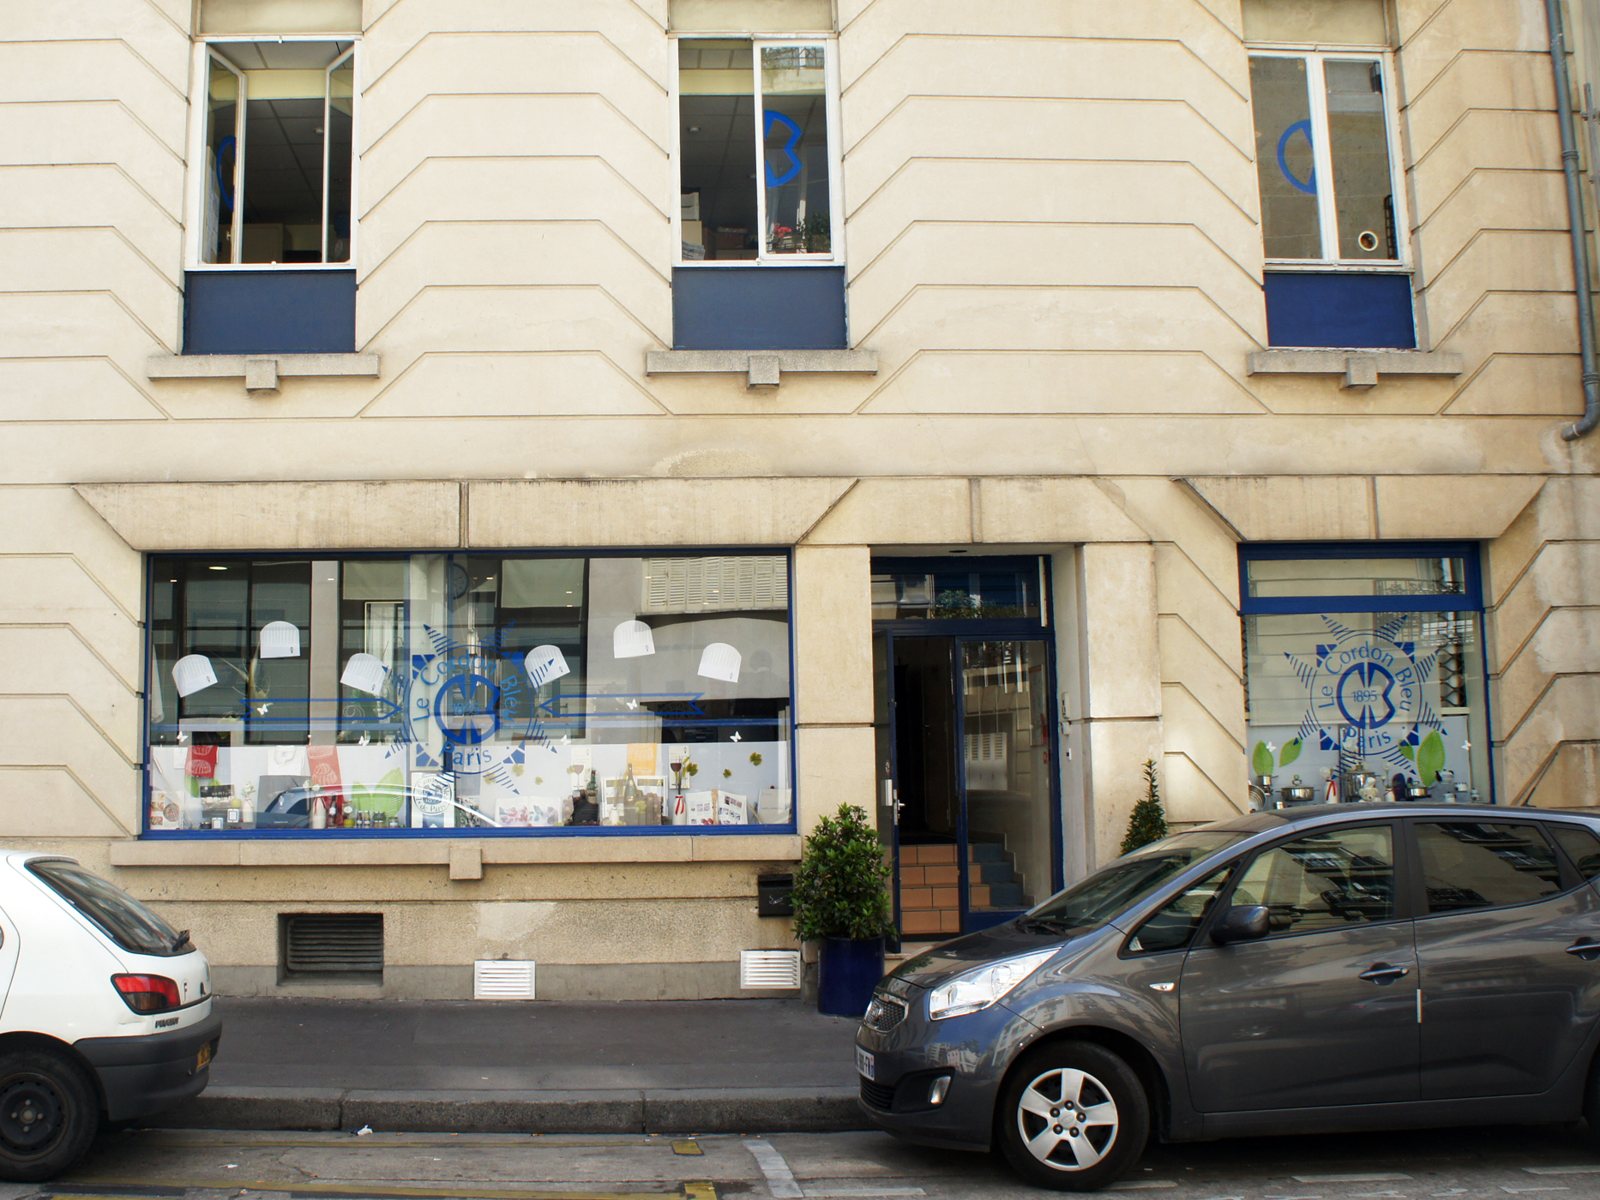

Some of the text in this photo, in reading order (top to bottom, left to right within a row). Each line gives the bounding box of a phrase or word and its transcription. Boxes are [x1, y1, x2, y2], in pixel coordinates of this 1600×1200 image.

[413, 649, 523, 723] Le Cordon Bleu
[1318, 641, 1416, 712] Le Cordon Bleu
[1352, 690, 1378, 703] 1895
[1342, 725, 1392, 748] Paris
[439, 741, 492, 766] Paris
